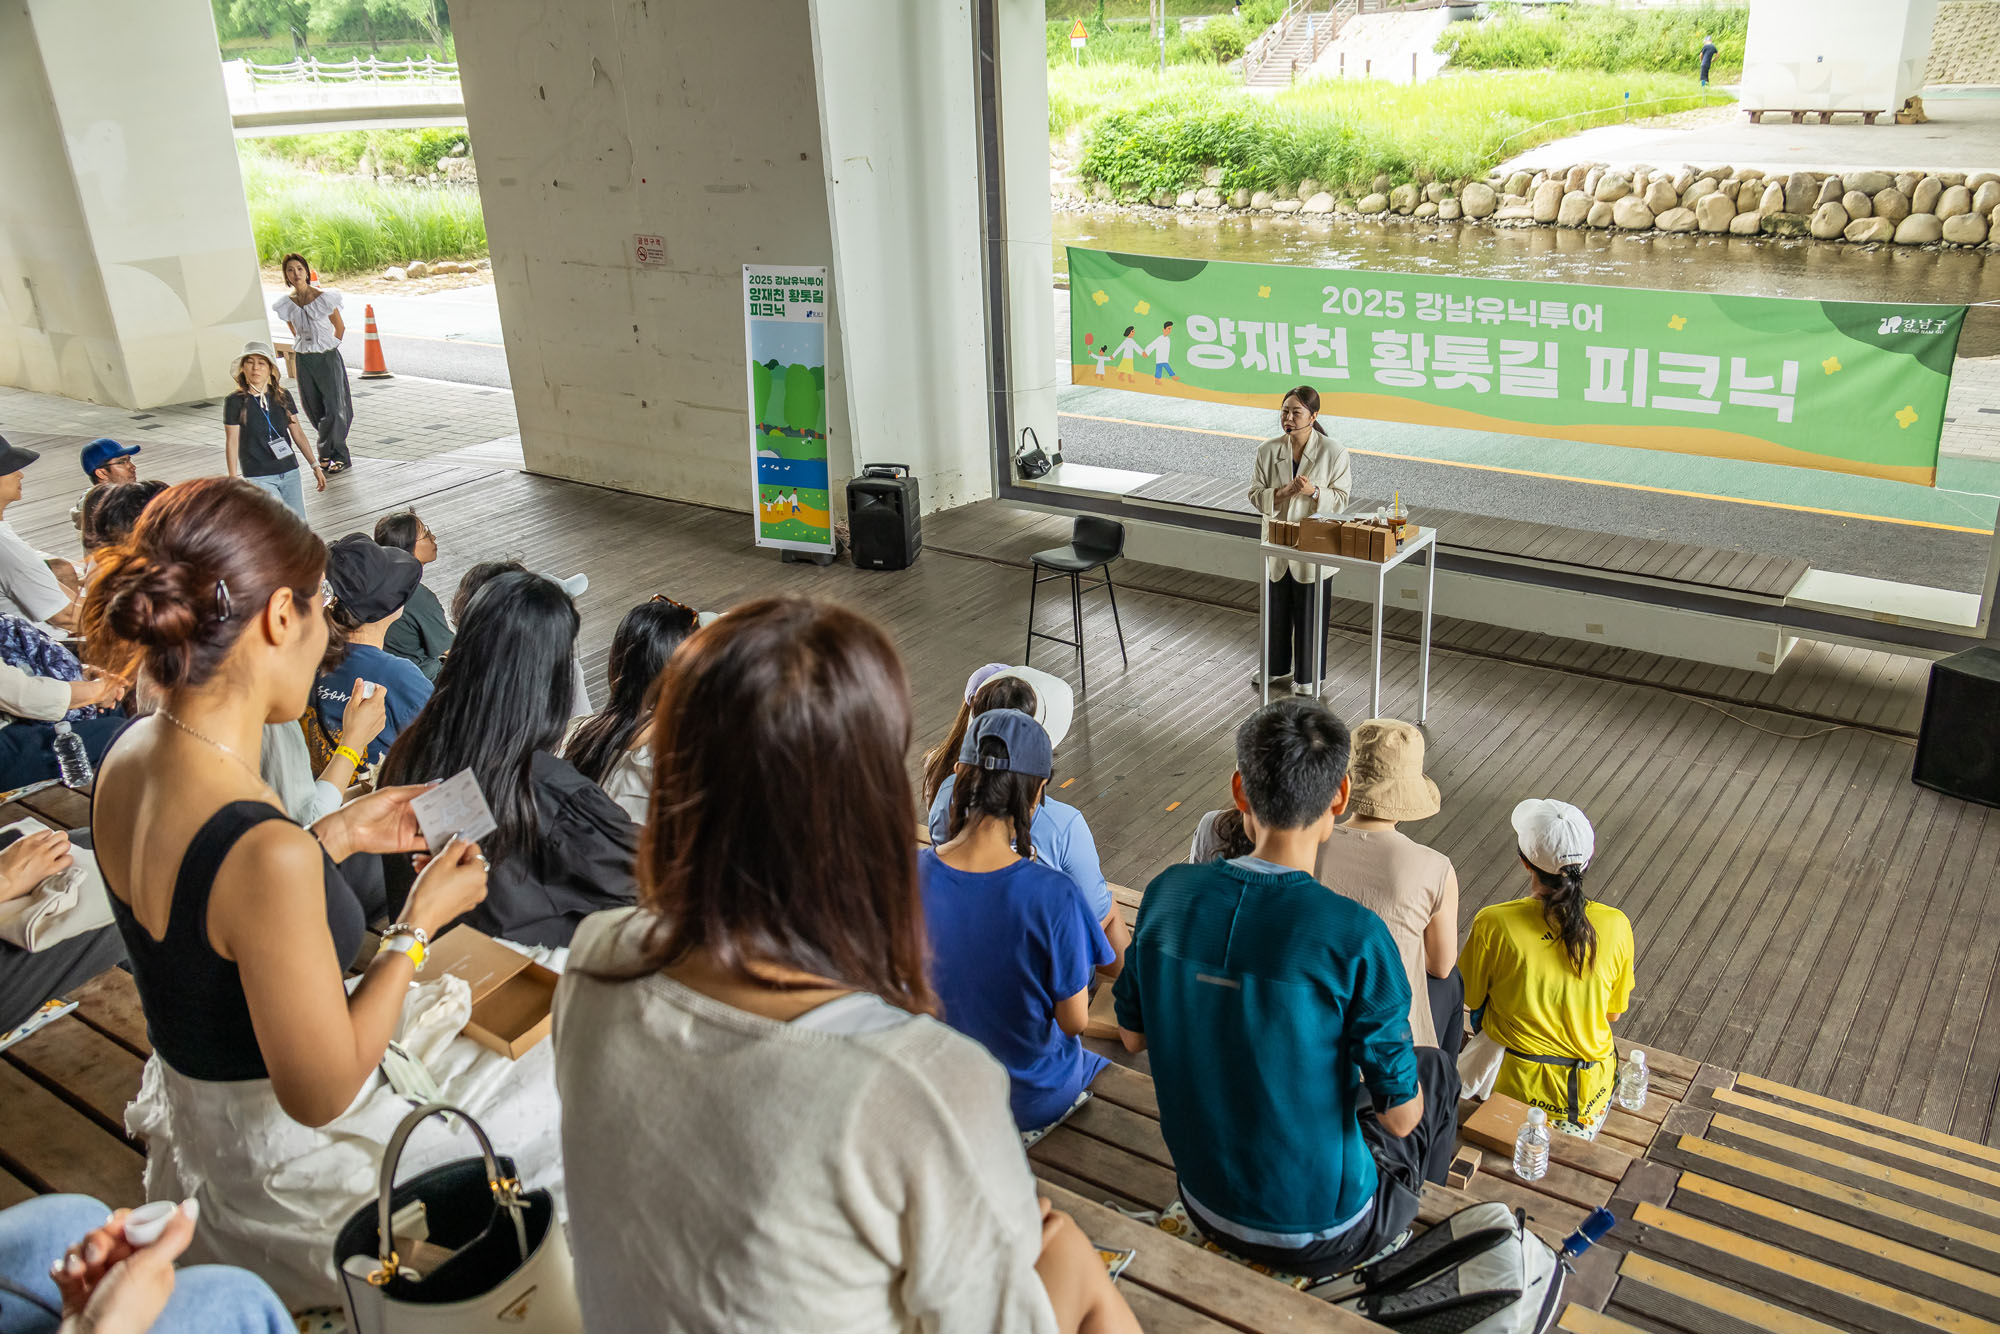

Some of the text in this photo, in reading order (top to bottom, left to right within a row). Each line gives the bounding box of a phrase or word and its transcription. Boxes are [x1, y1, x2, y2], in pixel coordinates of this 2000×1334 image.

[749, 275, 824, 286] 2025 강남유닉투어
[749, 287, 824, 303] 양재천 황톳길
[749, 303, 786, 317] 피크닉
[1321, 285, 1603, 333] 2025 강남유닉투어
[1903, 318, 1948, 330] 강남구
[1186, 314, 1799, 424] 양재천 황톳길 피크닉
[1529, 1098, 1569, 1115] ADIDAS
